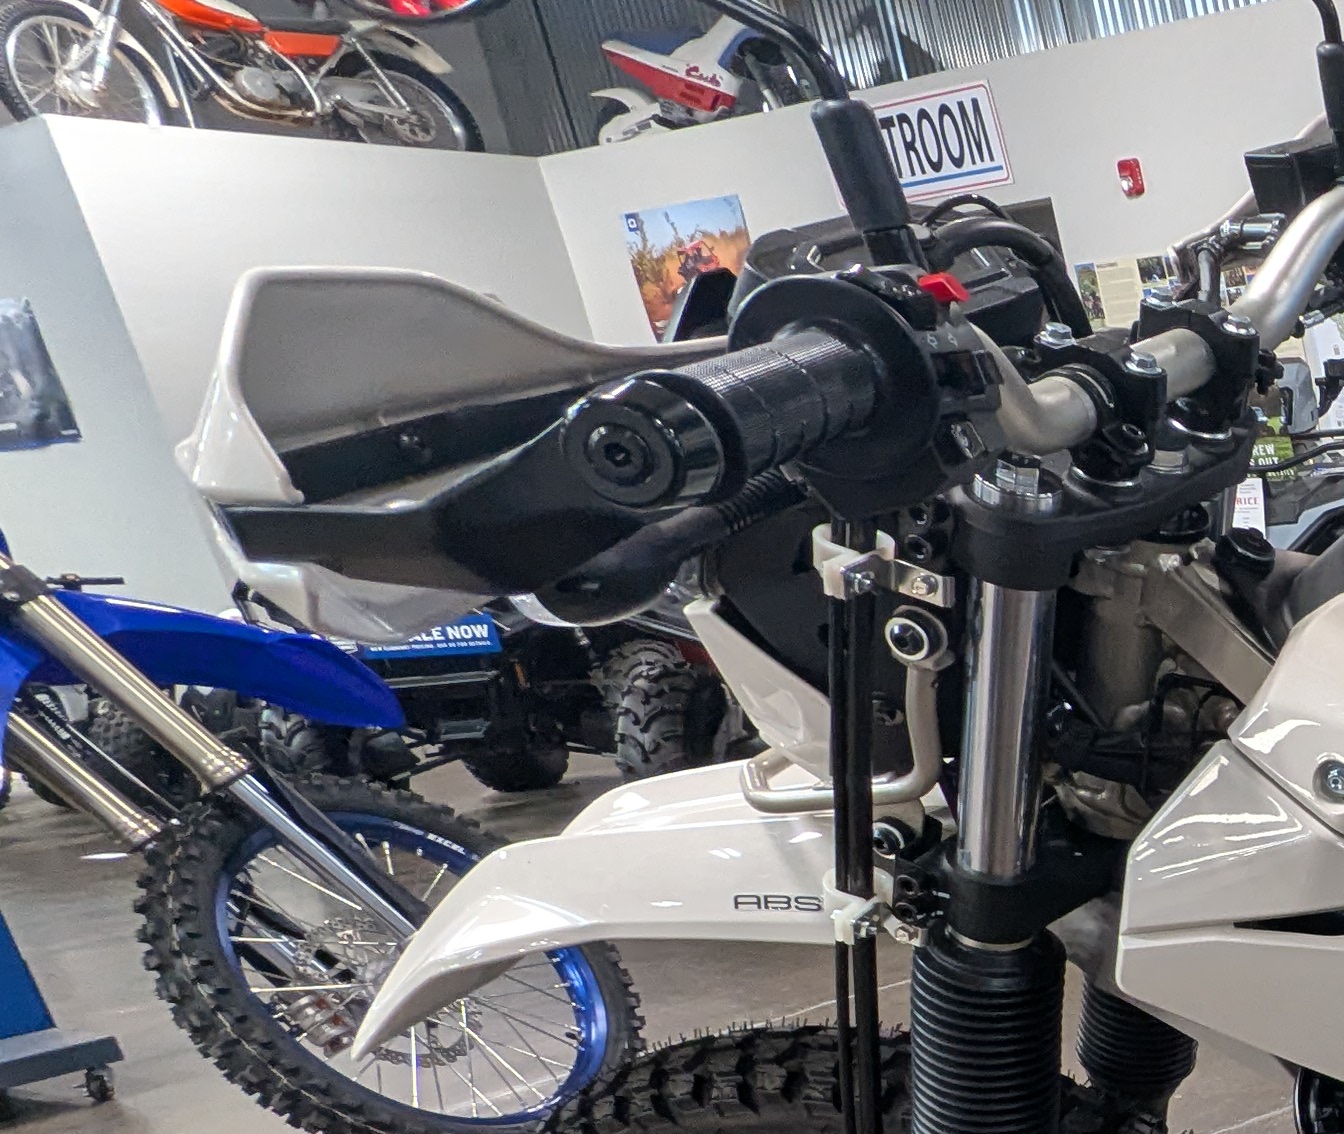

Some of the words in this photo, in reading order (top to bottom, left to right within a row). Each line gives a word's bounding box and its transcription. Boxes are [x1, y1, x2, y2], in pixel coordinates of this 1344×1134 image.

[878, 97, 995, 178] TROOM
[1252, 443, 1275, 456] REW
[1236, 496, 1260, 506] RICE
[446, 624, 489, 640] NOW
[733, 895, 824, 911] ABS
